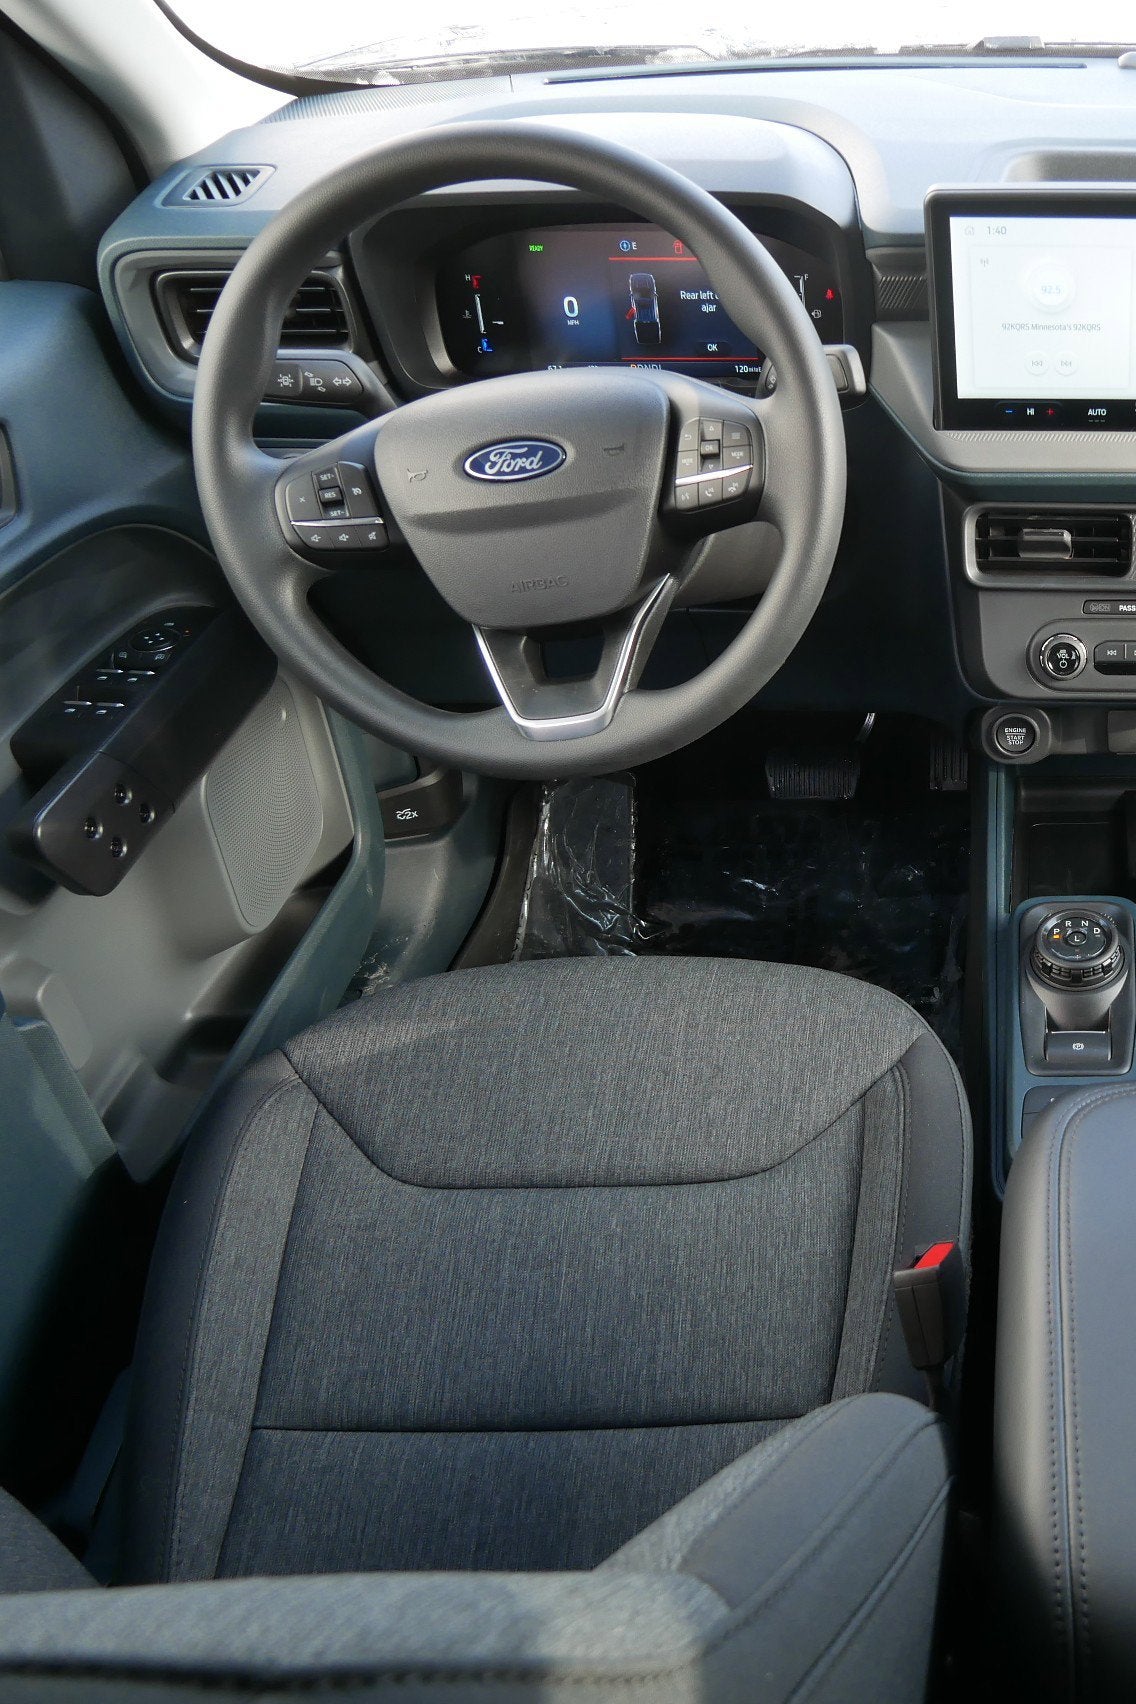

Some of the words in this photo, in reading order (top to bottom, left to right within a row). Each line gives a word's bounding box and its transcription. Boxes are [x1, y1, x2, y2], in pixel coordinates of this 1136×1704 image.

[986, 226, 1007, 235] 1:40
[680, 290, 698, 300] Rear
[700, 290, 714, 300] left
[563, 296, 579, 318] 0
[702, 303, 716, 314] ajar
[1031, 322, 1072, 332] Minnesota's
[707, 344, 718, 352] OK
[1026, 408, 1035, 416] HI
[1087, 408, 1107, 416] AUTO
[484, 447, 543, 475] Ford
